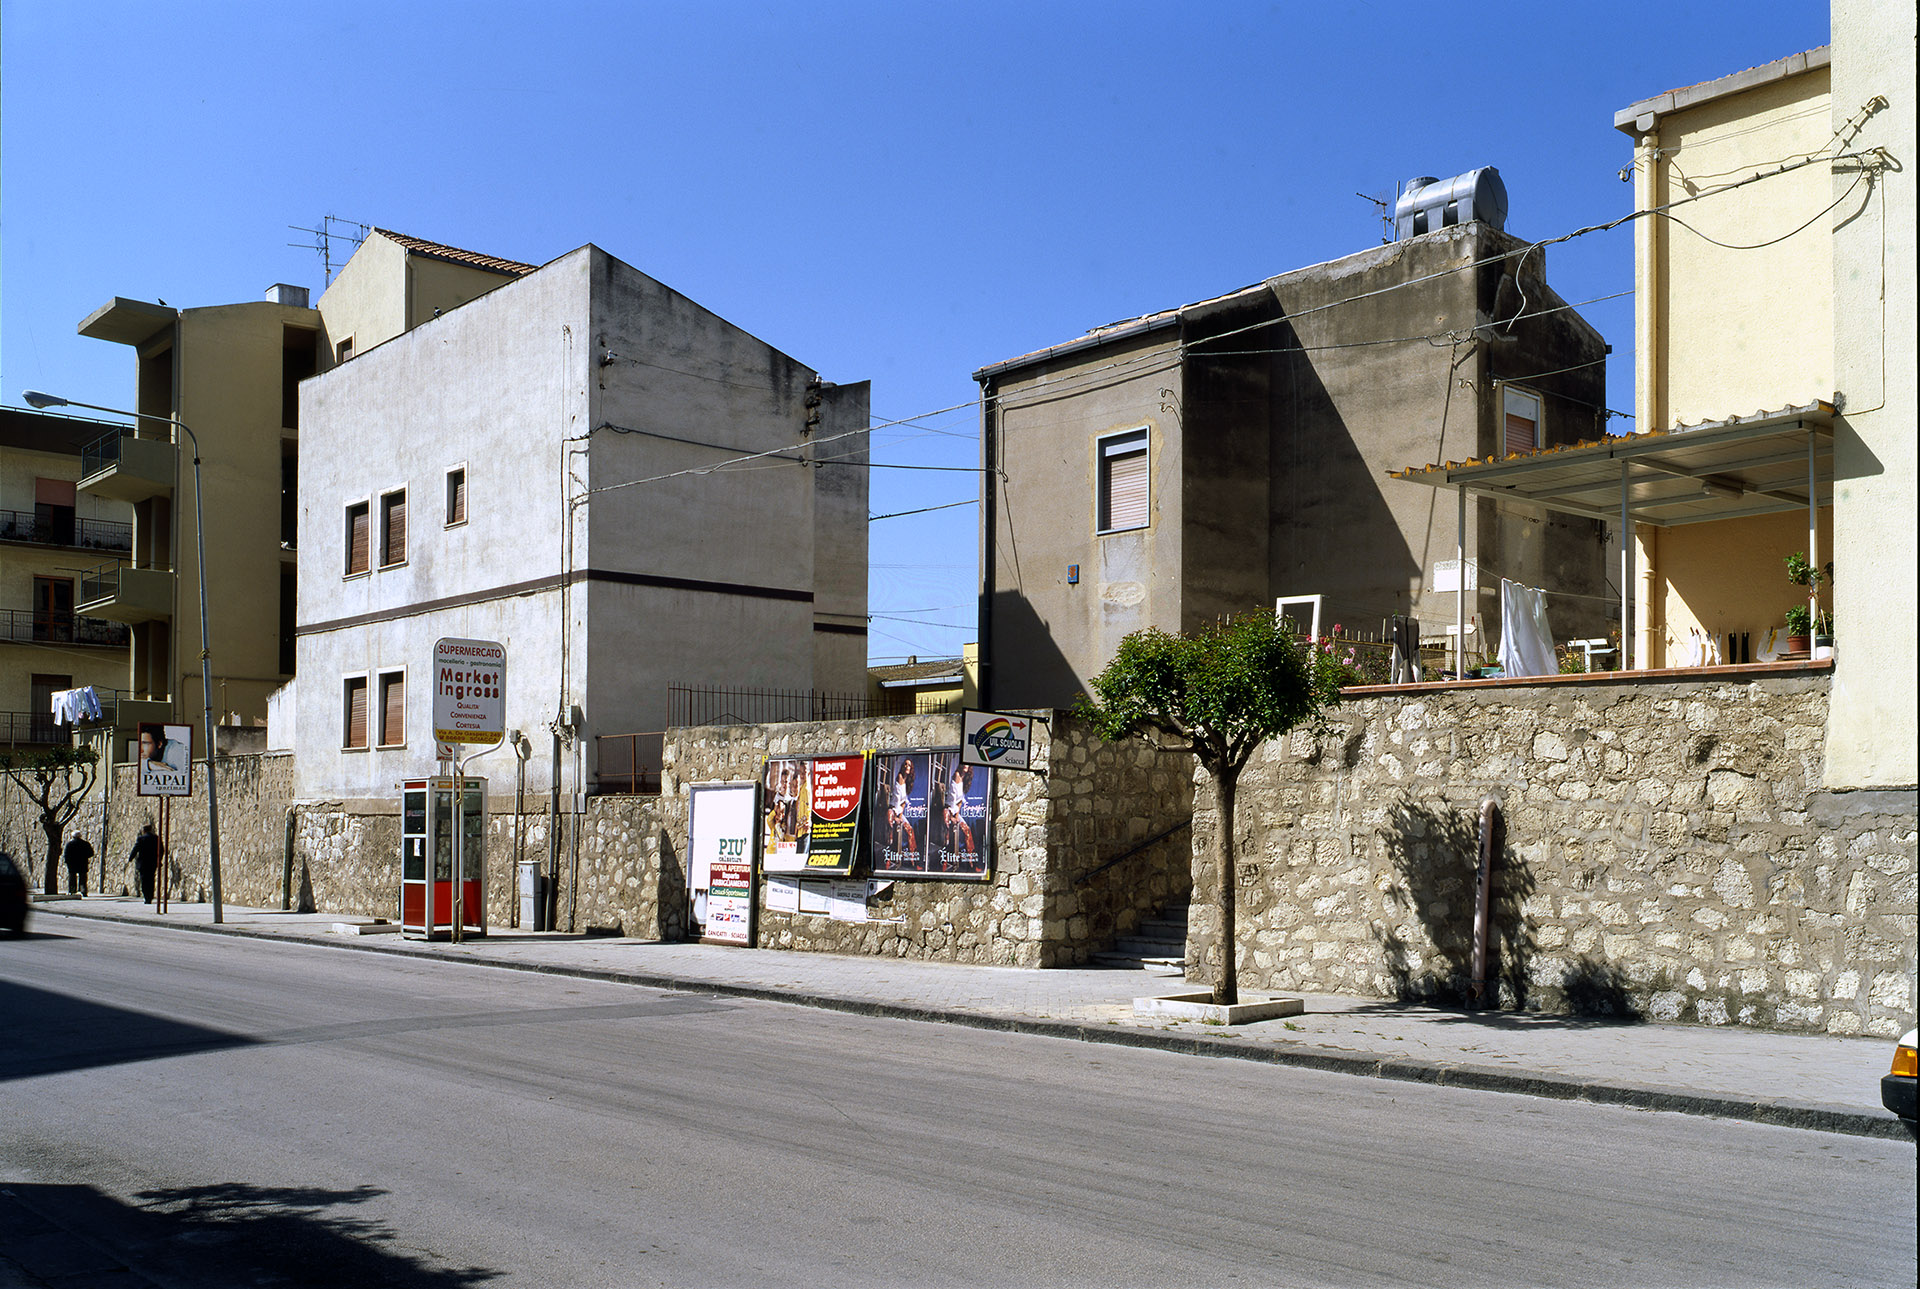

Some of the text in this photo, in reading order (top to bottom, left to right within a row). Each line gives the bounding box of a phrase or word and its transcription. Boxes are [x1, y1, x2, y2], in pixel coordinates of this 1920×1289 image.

[439, 645, 501, 658] SUPERMERCATO
[470, 660, 501, 668] gastronomia
[440, 668, 498, 685] Market
[440, 682, 499, 700] Ingross
[450, 711, 486, 719] CONVENIENZA
[456, 721, 480, 729] CORTESIA
[990, 738, 1022, 749] UIL SCUOLA
[1005, 756, 1024, 765] Sciacca
[815, 761, 846, 774] Impara
[143, 775, 186, 785] PAPAI
[815, 774, 838, 785] l'arte
[815, 786, 856, 797] di mettere
[814, 798, 849, 811] da parte
[719, 837, 746, 856] PIU'
[808, 854, 840, 866] CREDEM
[882, 846, 902, 864] Élite
[938, 847, 960, 865] Élite
[711, 864, 727, 872] NUOVA
